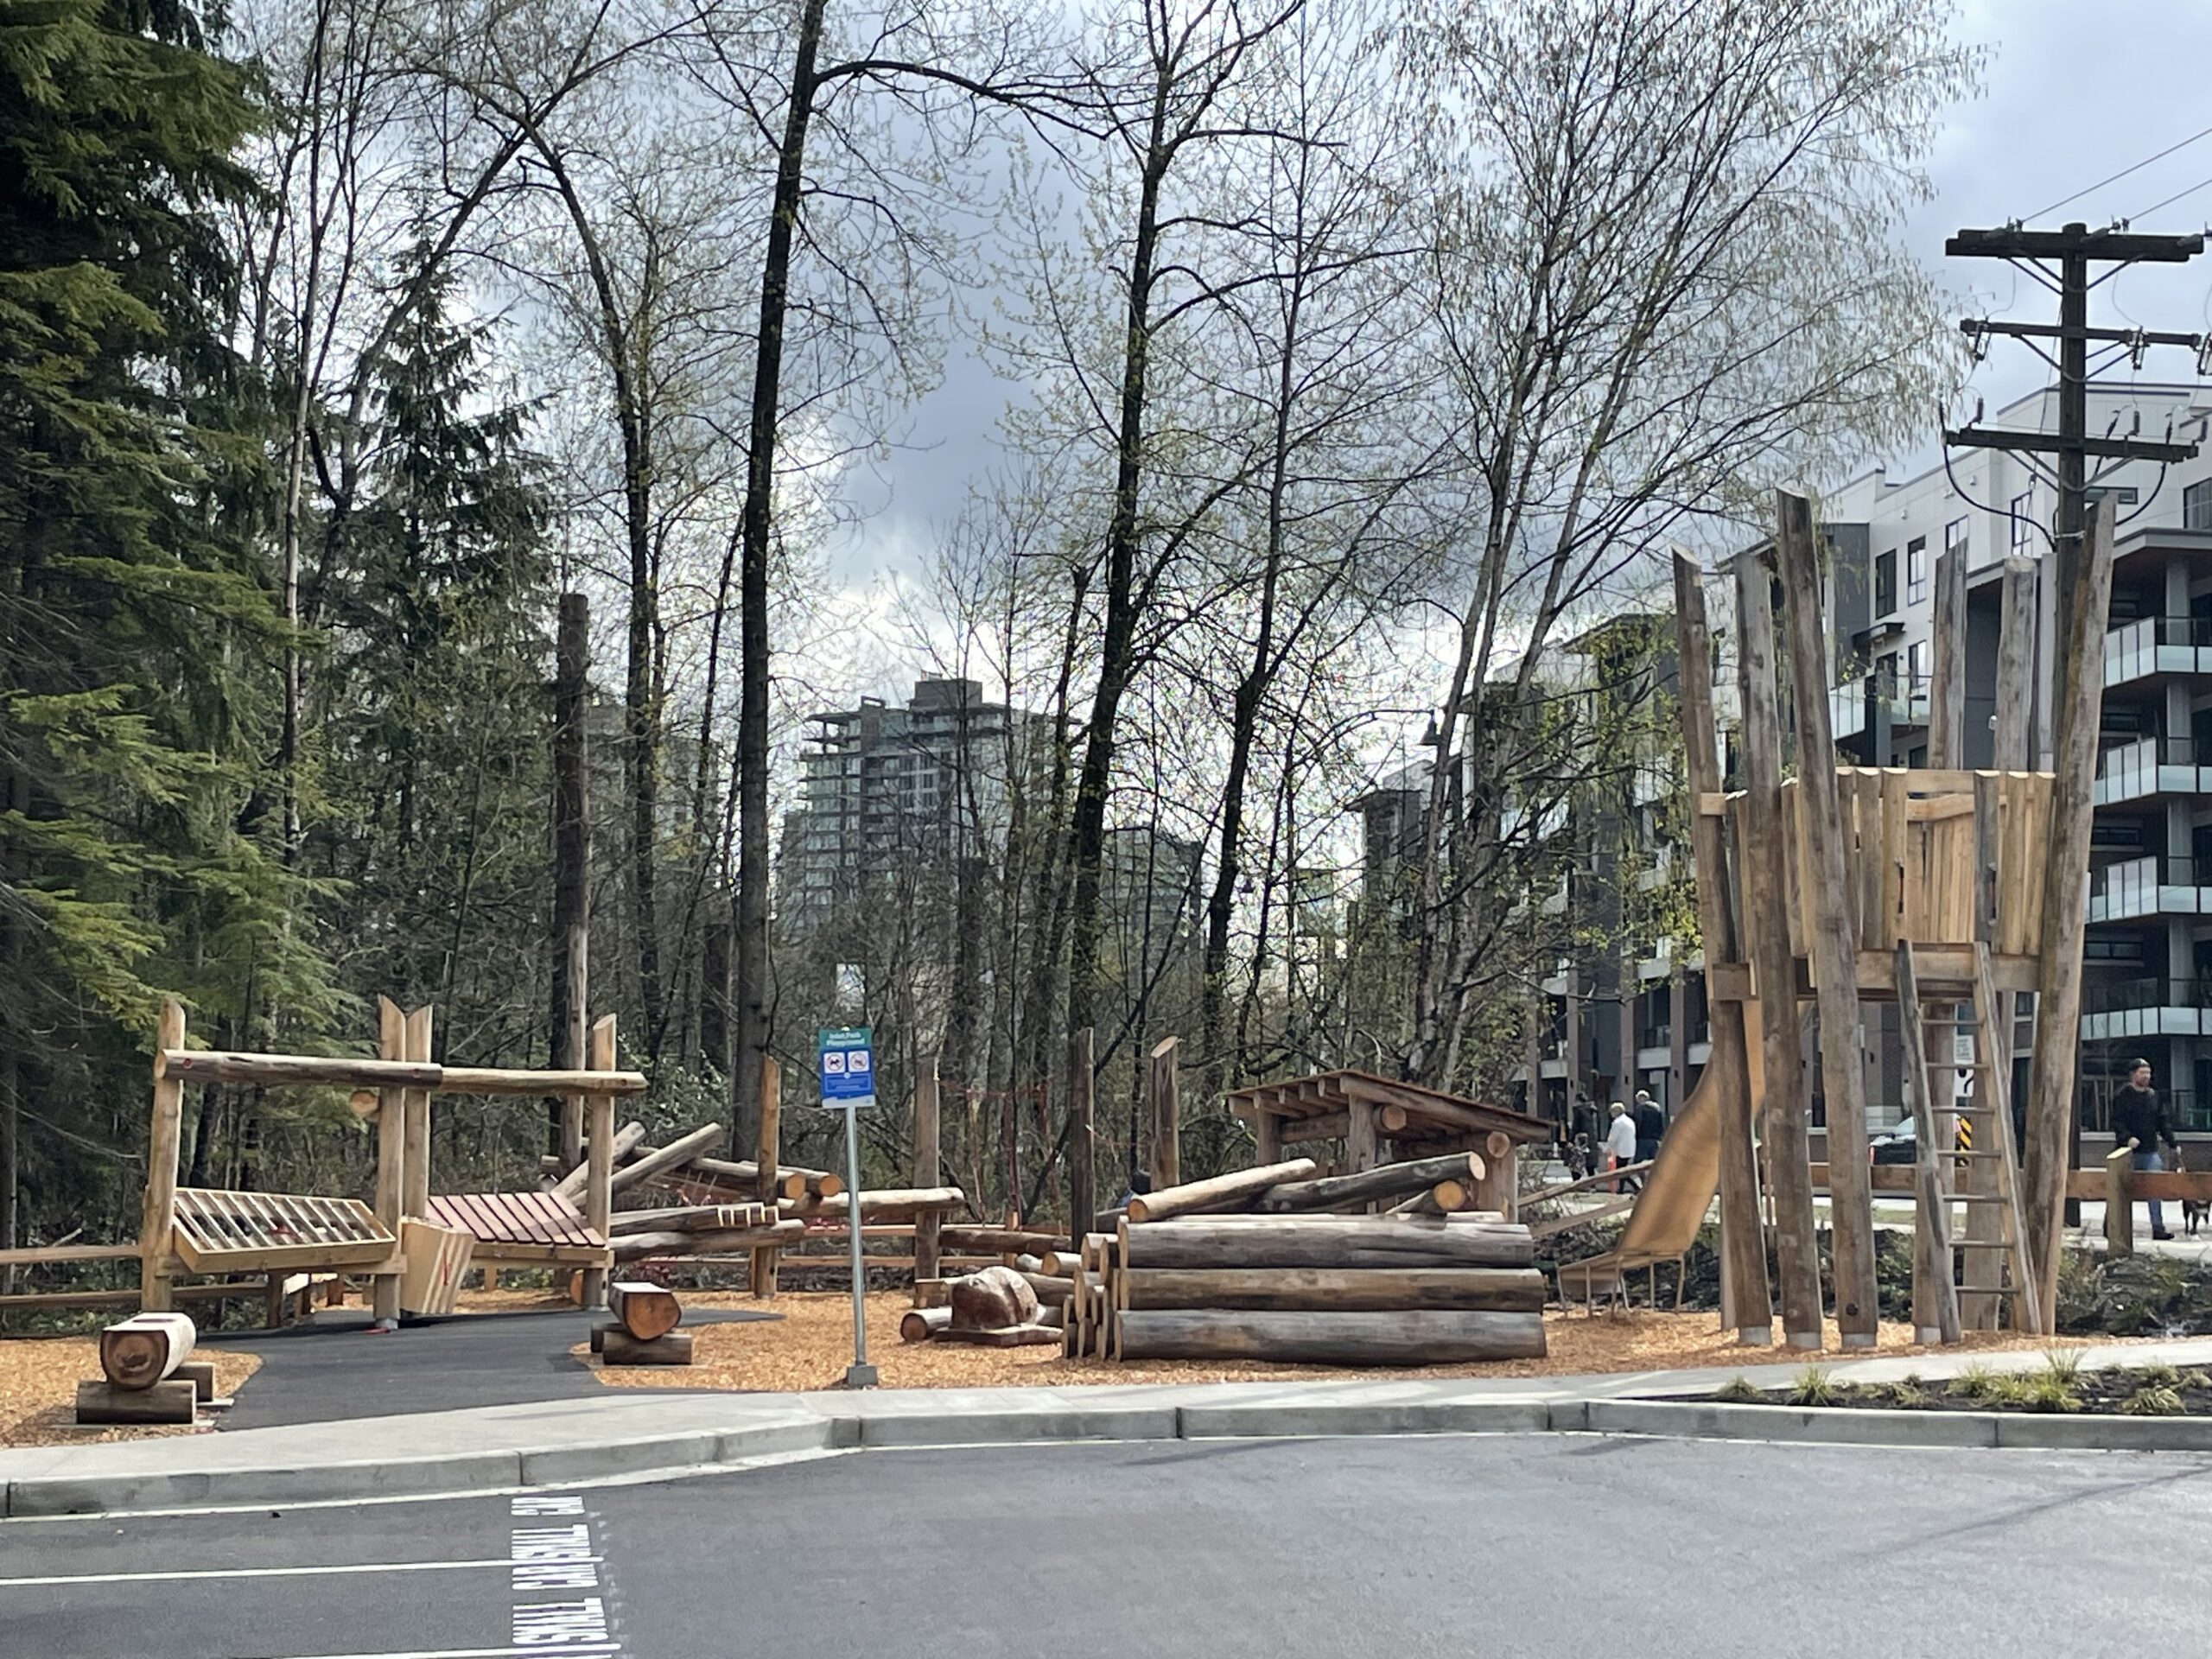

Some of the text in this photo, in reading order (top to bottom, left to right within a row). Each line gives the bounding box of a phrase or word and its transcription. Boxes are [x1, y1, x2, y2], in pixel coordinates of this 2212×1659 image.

[512, 1496, 591, 1559] SMALL CAR
[512, 1564, 598, 1590] CAR
[512, 1598, 608, 1644] SMALL
